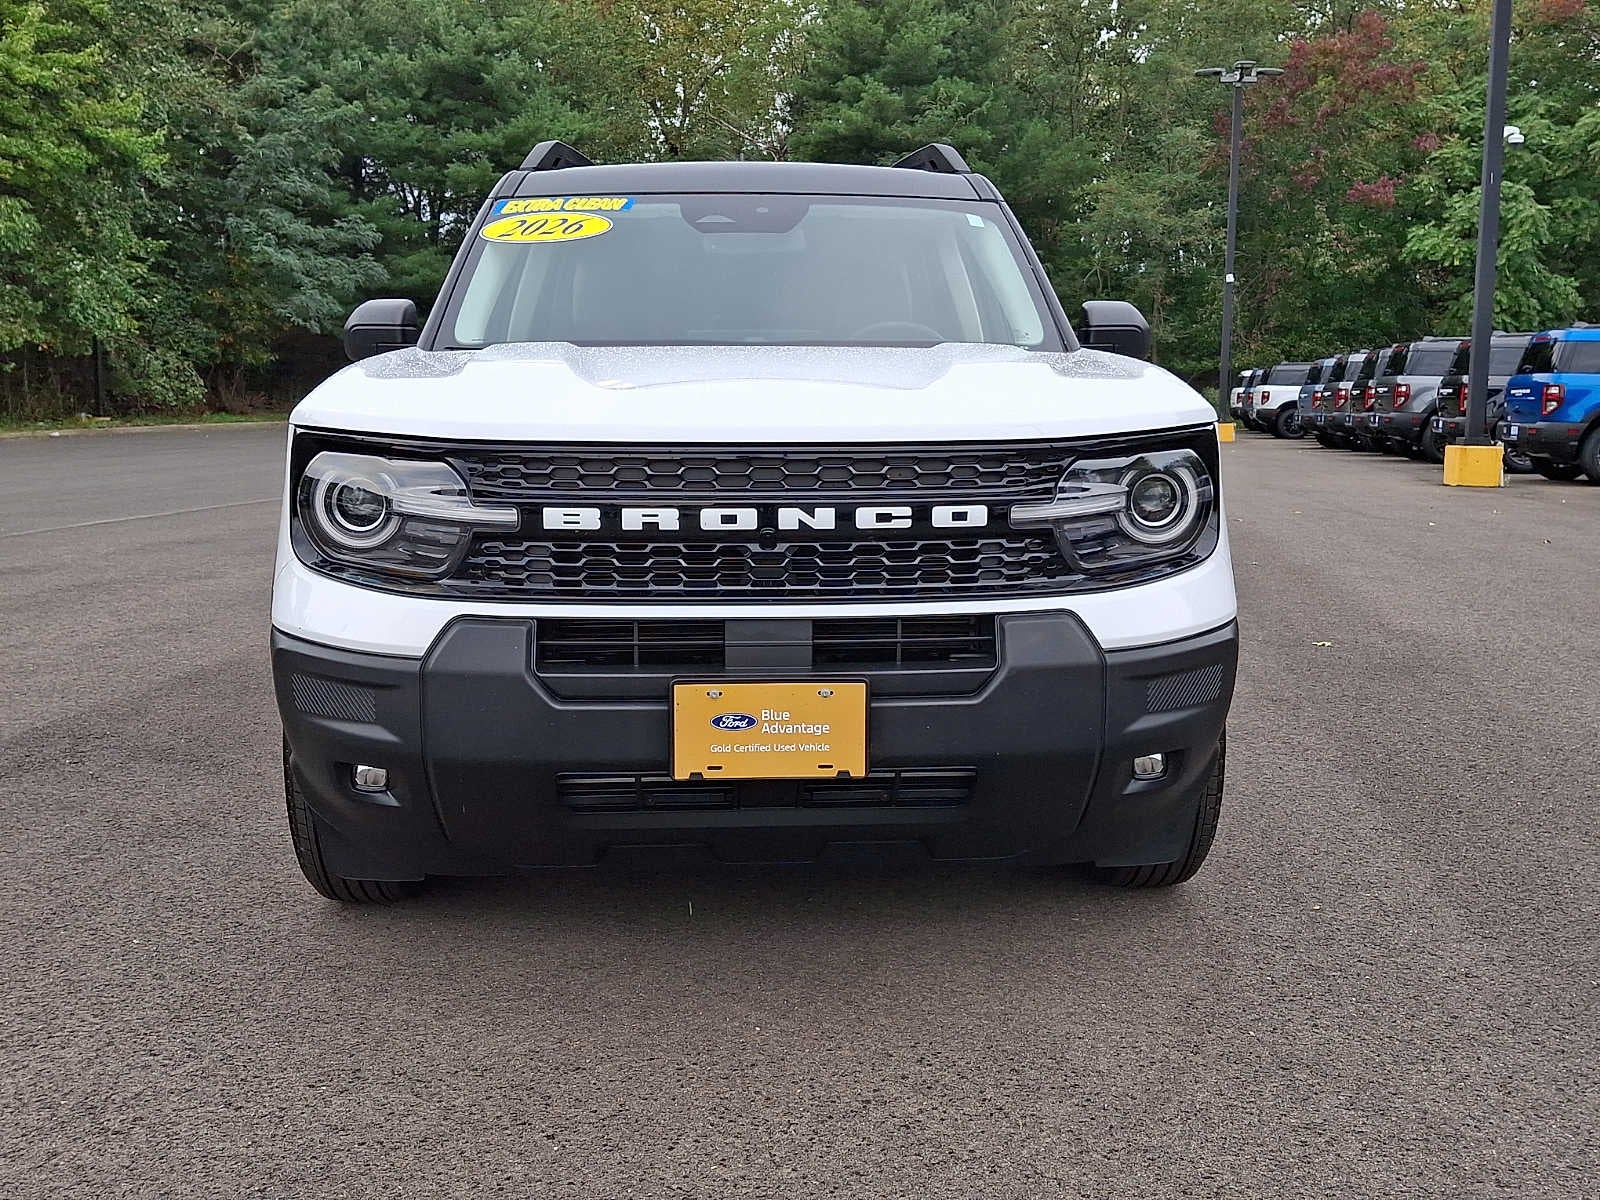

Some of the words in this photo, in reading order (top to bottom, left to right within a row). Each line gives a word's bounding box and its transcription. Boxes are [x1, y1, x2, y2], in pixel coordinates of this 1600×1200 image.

[501, 199, 564, 214] EXTRA
[563, 198, 628, 211] CLEAN
[497, 218, 594, 238] 2026
[542, 504, 988, 531] BRONCO
[761, 709, 790, 721] Blue
[761, 722, 831, 736] Advantage
[710, 743, 731, 753] Gold
[733, 743, 771, 753] Certified
[773, 743, 796, 752] Used
[798, 742, 831, 752] Vehicle
